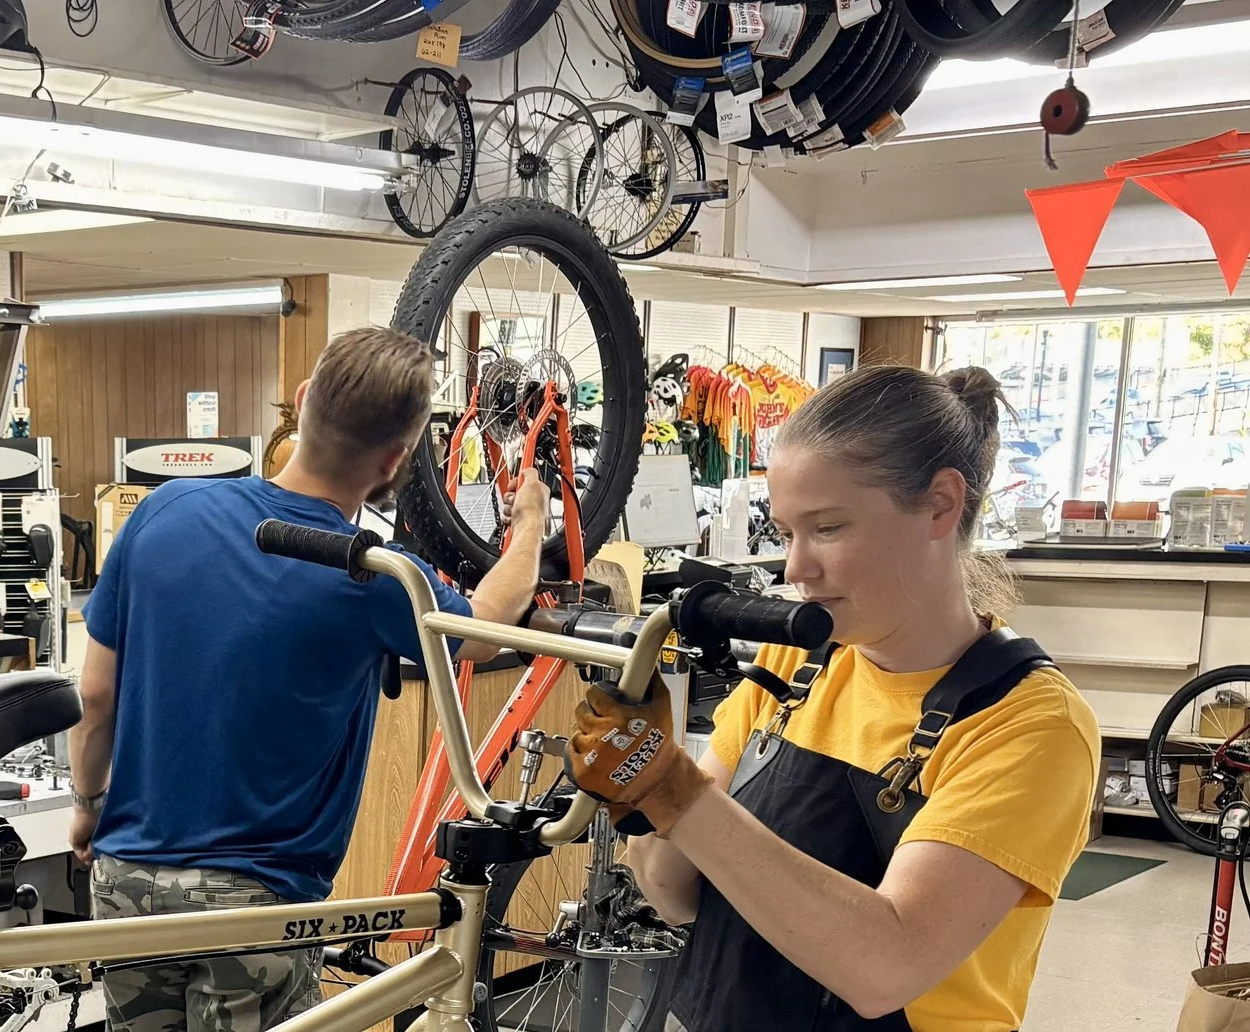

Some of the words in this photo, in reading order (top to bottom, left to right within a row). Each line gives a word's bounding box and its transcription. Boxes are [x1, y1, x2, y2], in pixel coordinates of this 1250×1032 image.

[161, 453, 214, 462] TREK
[609, 729, 657, 780] TOOLS
[620, 730, 665, 785] KLEIN
[282, 918, 324, 941] SIX
[341, 909, 405, 934] PACK
[1207, 904, 1228, 967] BONT
